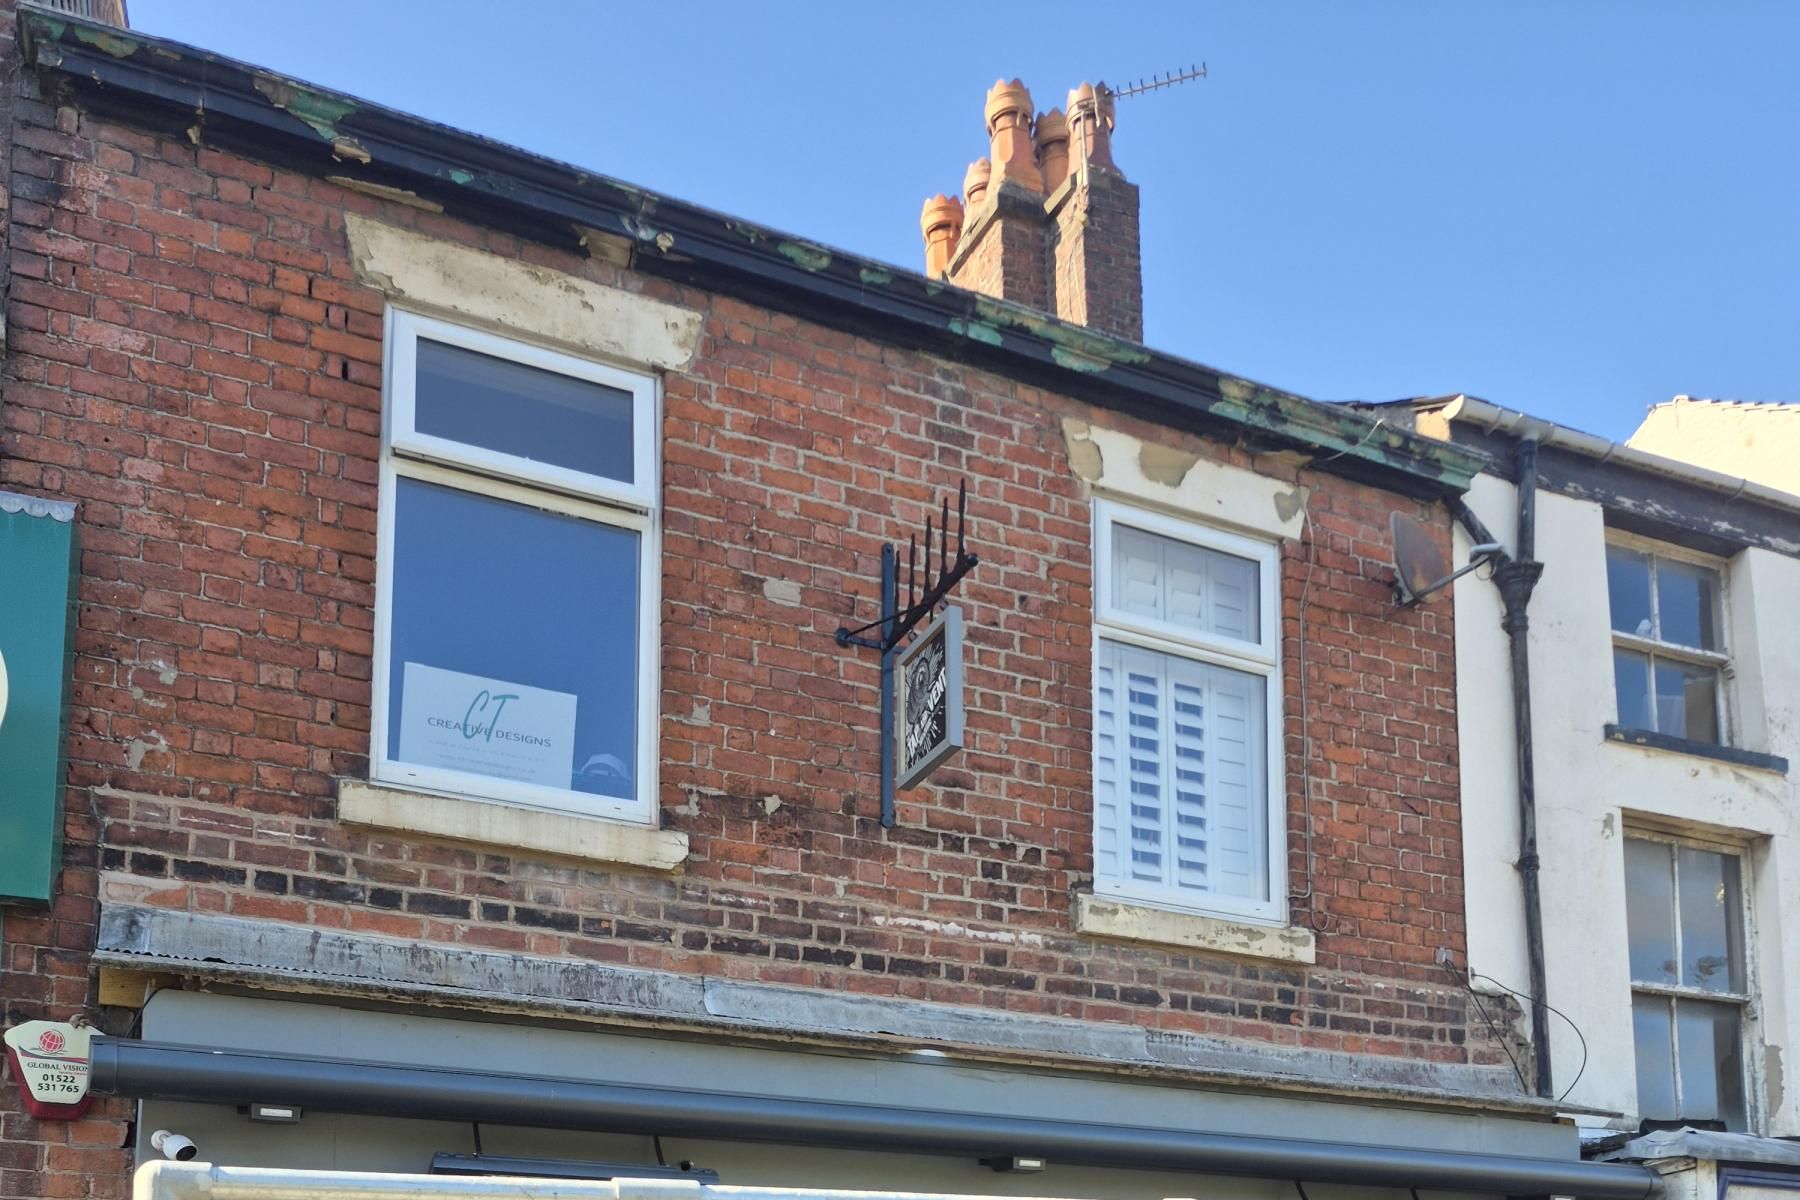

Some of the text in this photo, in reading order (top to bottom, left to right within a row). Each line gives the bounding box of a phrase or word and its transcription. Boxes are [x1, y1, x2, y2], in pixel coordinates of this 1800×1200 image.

[495, 730, 552, 748] DESIGNS
[27, 1061, 61, 1070] GLOBAL
[42, 1073, 75, 1083] 01522
[37, 1083, 79, 1093] 531 765
